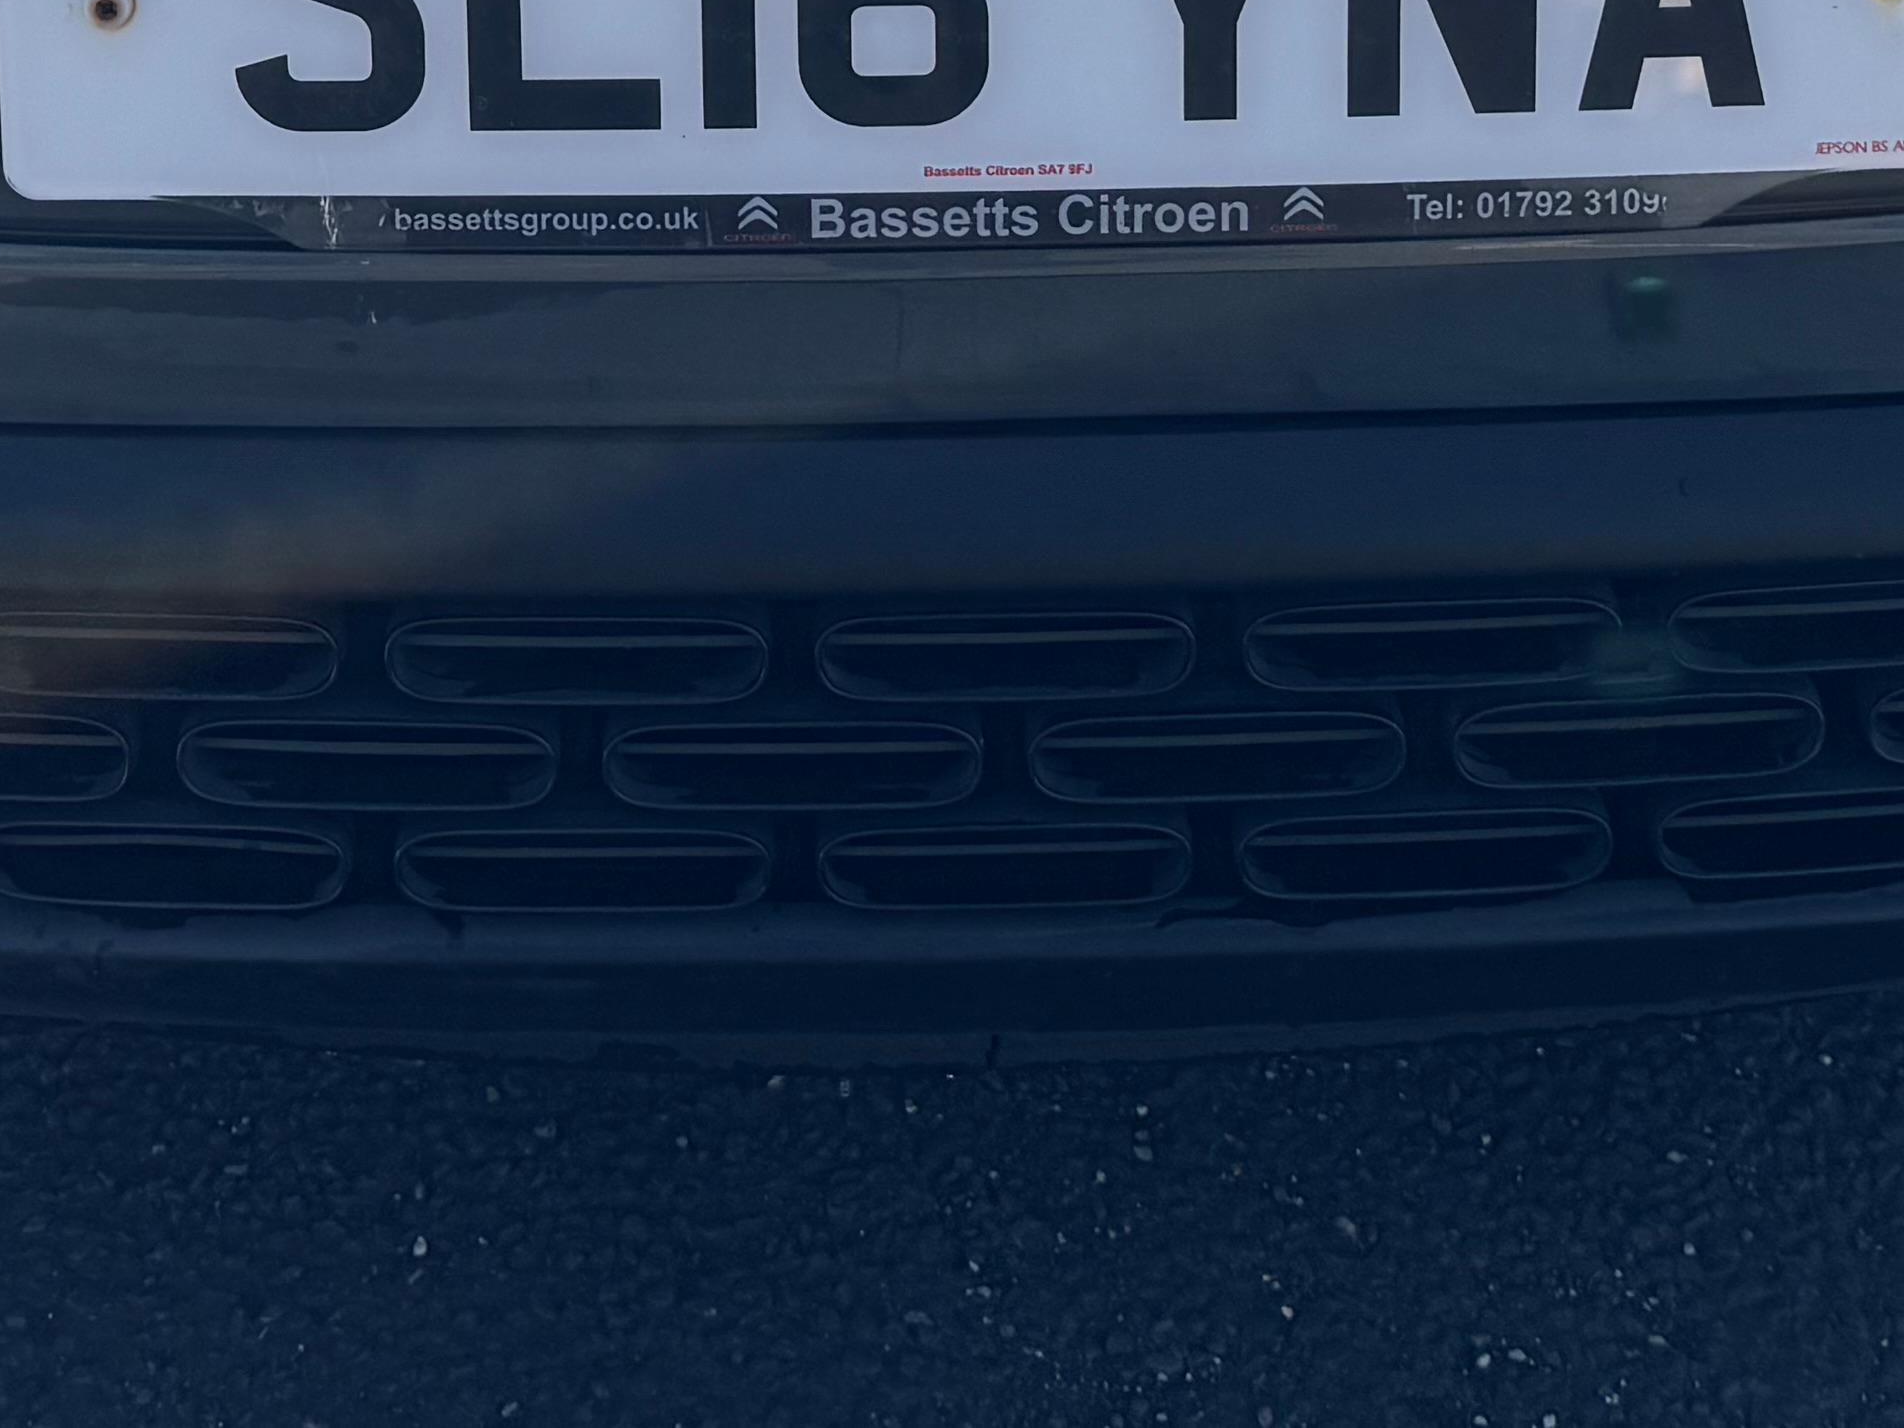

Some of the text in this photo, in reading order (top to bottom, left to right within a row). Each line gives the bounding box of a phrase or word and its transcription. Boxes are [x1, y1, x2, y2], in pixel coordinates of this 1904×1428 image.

[1871, 140, 1889, 153] BS
[923, 165, 982, 178] Bassetts
[985, 164, 1035, 177] Citroen
[1038, 163, 1065, 176] SA7
[810, 193, 1249, 240] Bassetts Citroen
[1406, 187, 1668, 220] Tel: 01792 3109
[378, 206, 700, 237] bassettsgroup.co.uk
